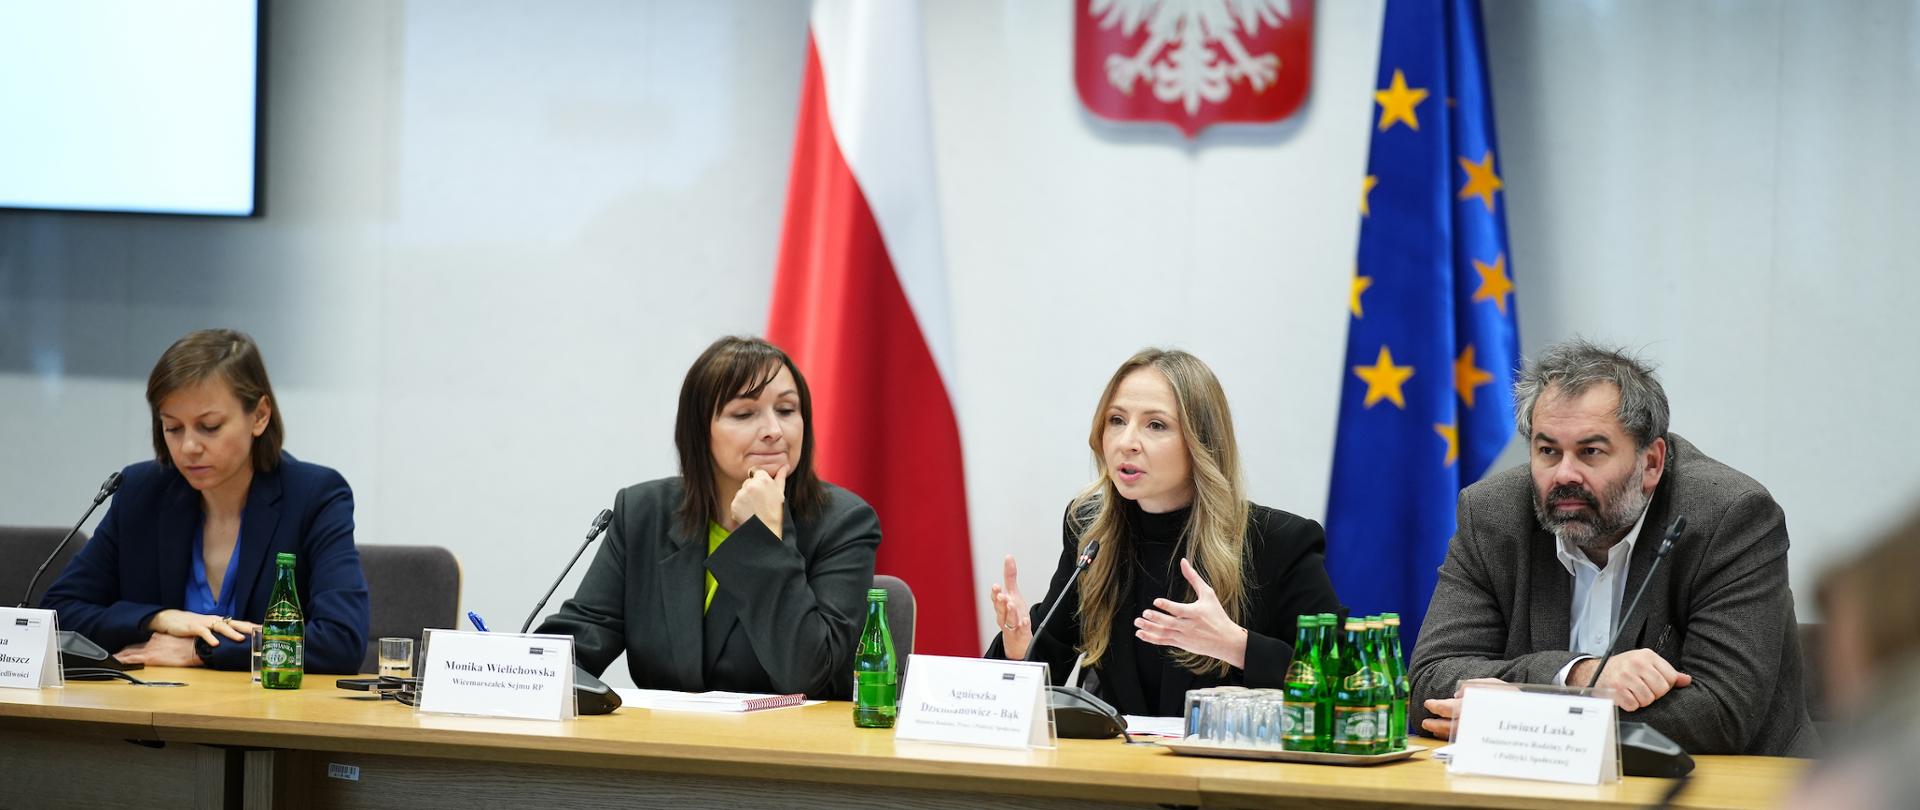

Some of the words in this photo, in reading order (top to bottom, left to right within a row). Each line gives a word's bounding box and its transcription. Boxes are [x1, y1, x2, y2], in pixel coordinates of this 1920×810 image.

[445, 660, 483, 672] Monika
[487, 663, 555, 677] Wielichowska
[508, 681, 530, 691] Sejmu
[532, 683, 544, 691] RP
[949, 689, 997, 701] Agnieszka
[1000, 708, 1019, 721] Bąk
[1498, 720, 1540, 734] Liwiusz
